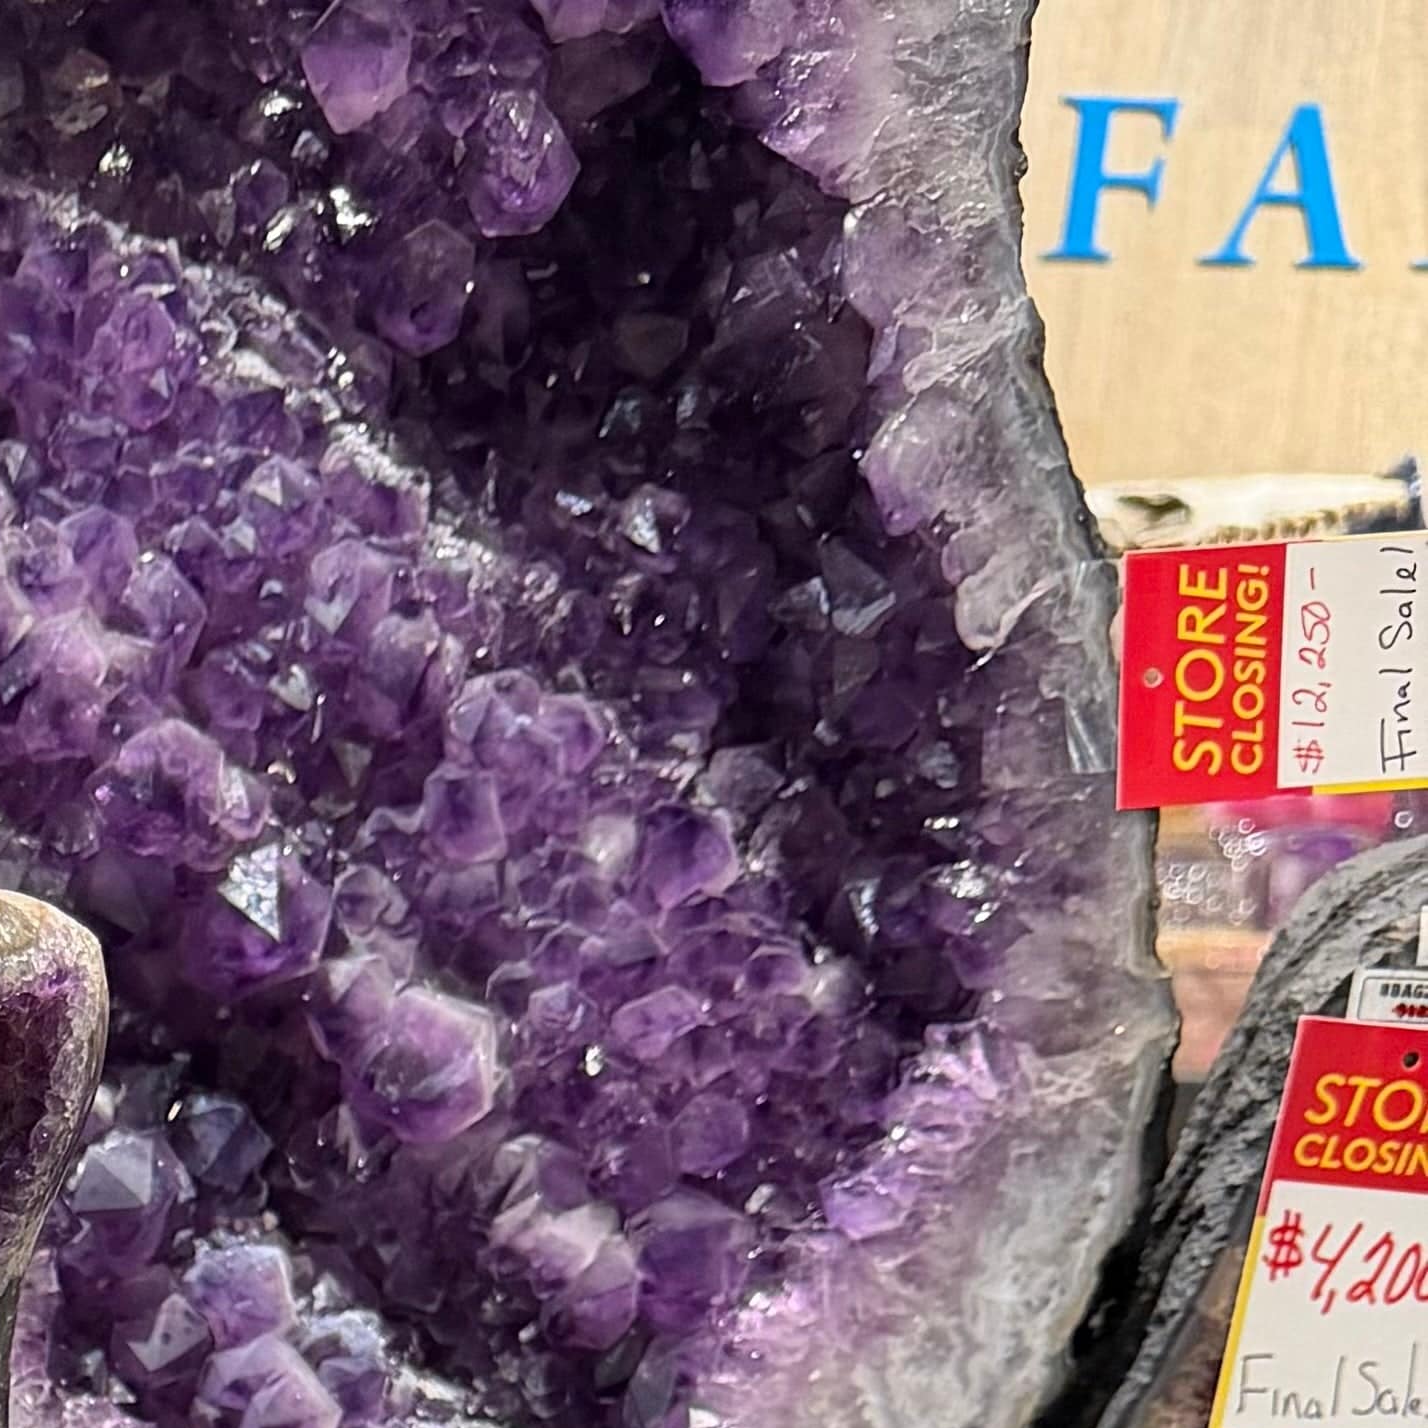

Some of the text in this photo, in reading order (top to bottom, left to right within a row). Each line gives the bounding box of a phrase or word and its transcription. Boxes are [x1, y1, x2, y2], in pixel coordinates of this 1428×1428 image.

[1037, 95, 1428, 272] FA
[1172, 563, 1229, 776] STORE
[1231, 562, 1271, 775] CLOSING!
[1378, 667, 1418, 774] Final
[1303, 1072, 1428, 1133] STO
[1236, 1352, 1347, 1420] Final
